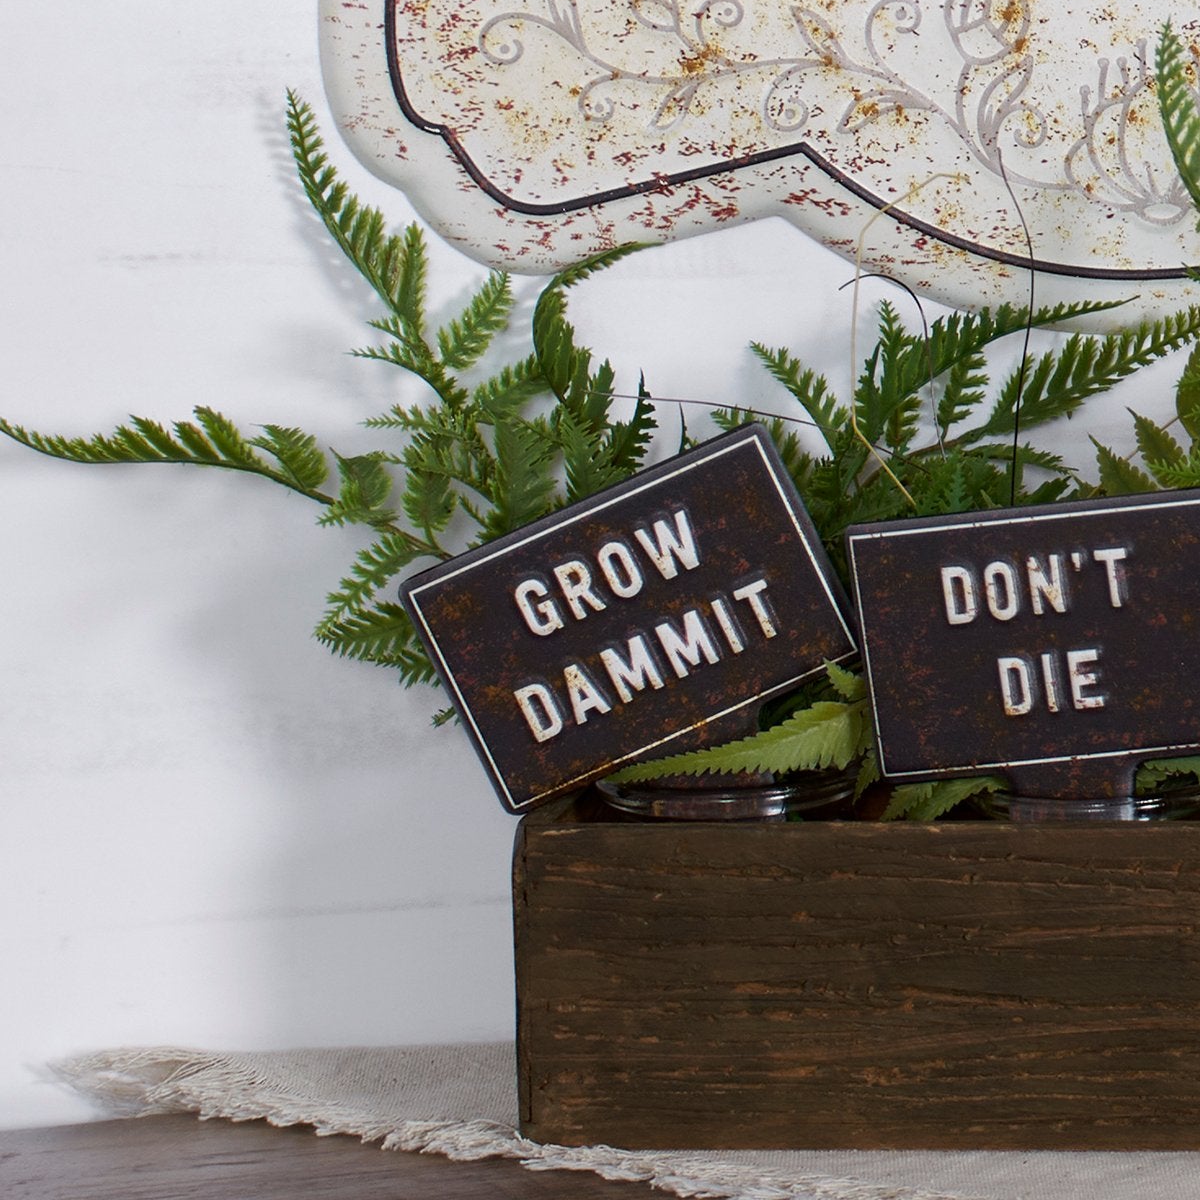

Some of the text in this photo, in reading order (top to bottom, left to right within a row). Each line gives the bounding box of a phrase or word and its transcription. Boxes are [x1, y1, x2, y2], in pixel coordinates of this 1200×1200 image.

[514, 509, 700, 636] GROW
[941, 547, 1130, 626] DON'T
[513, 576, 779, 743] DAMMIT
[997, 649, 1105, 717] DIE
